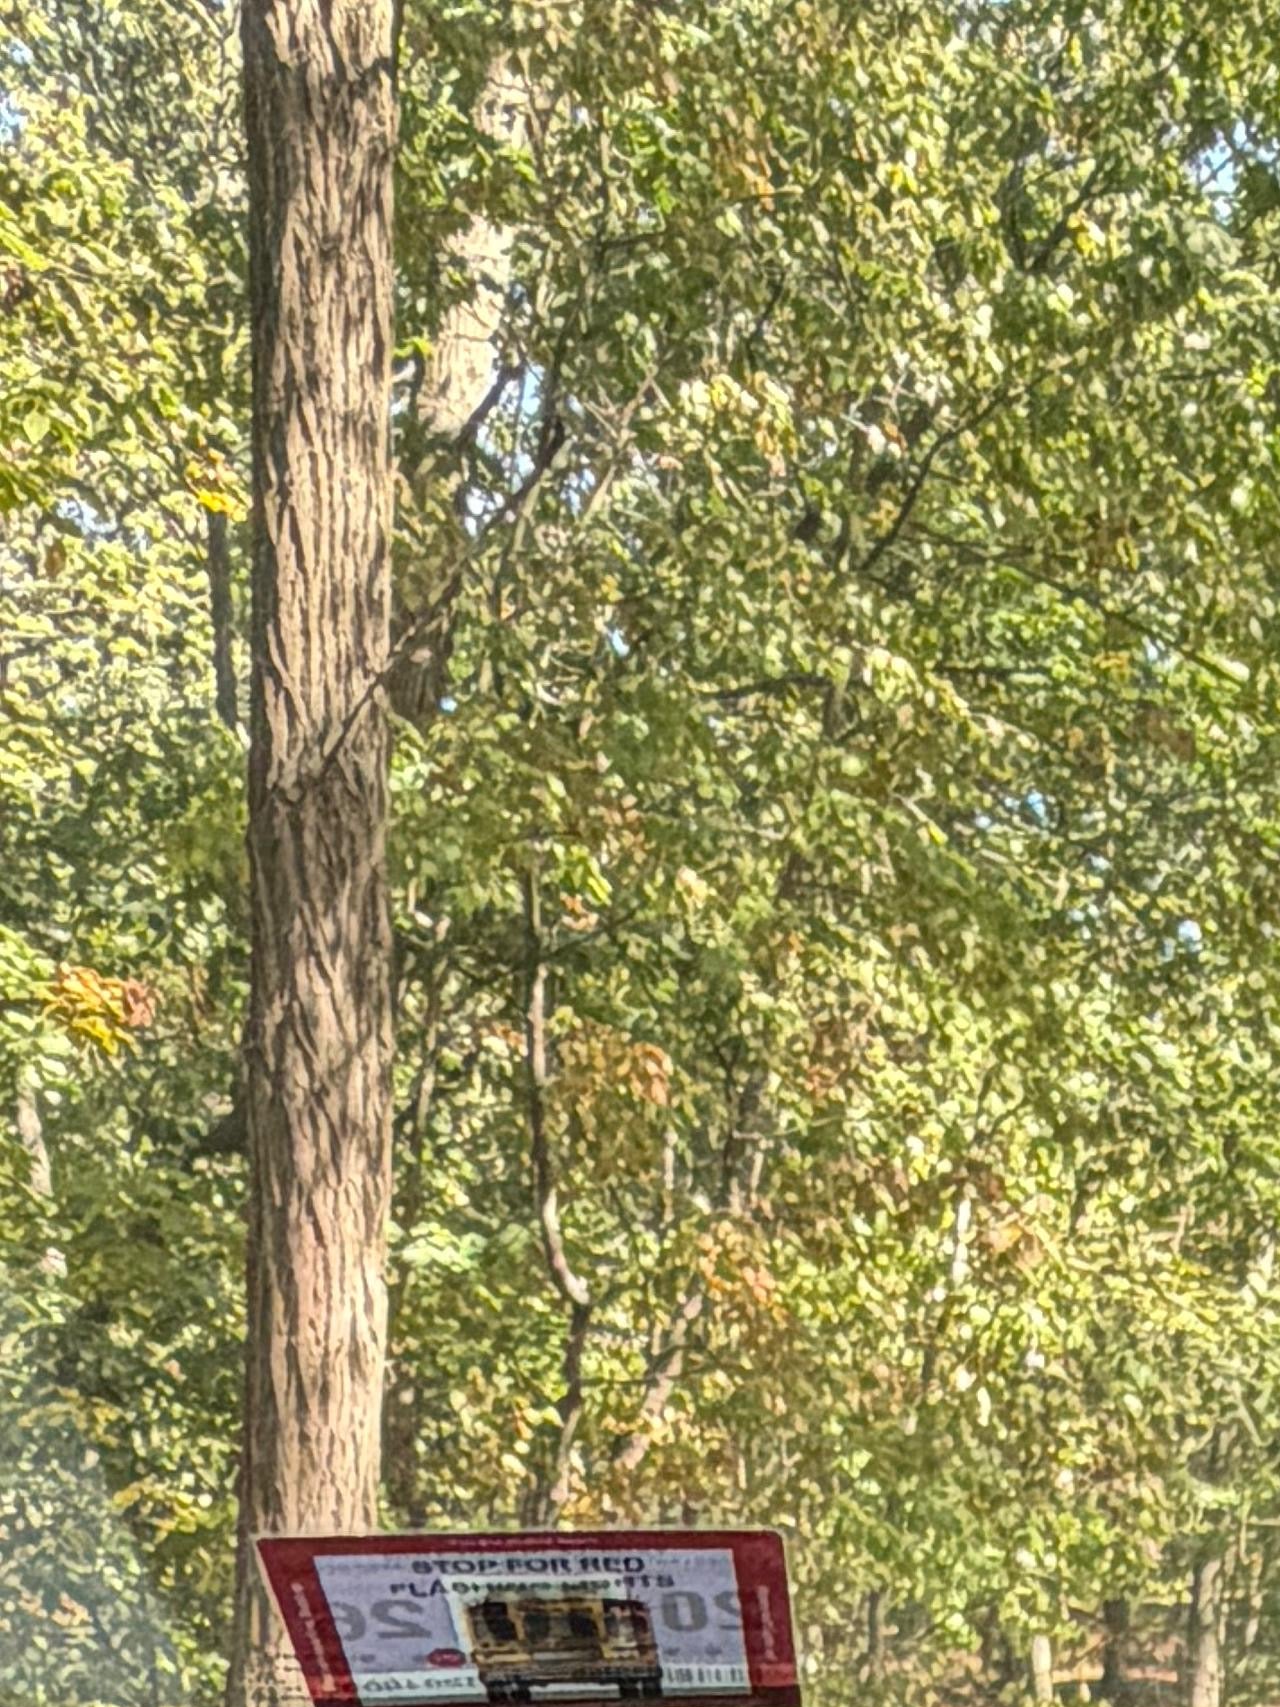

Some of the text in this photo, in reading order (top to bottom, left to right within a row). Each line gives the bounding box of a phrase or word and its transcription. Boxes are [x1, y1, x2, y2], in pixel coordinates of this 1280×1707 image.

[411, 1556, 645, 1575] STOP FOR RED
